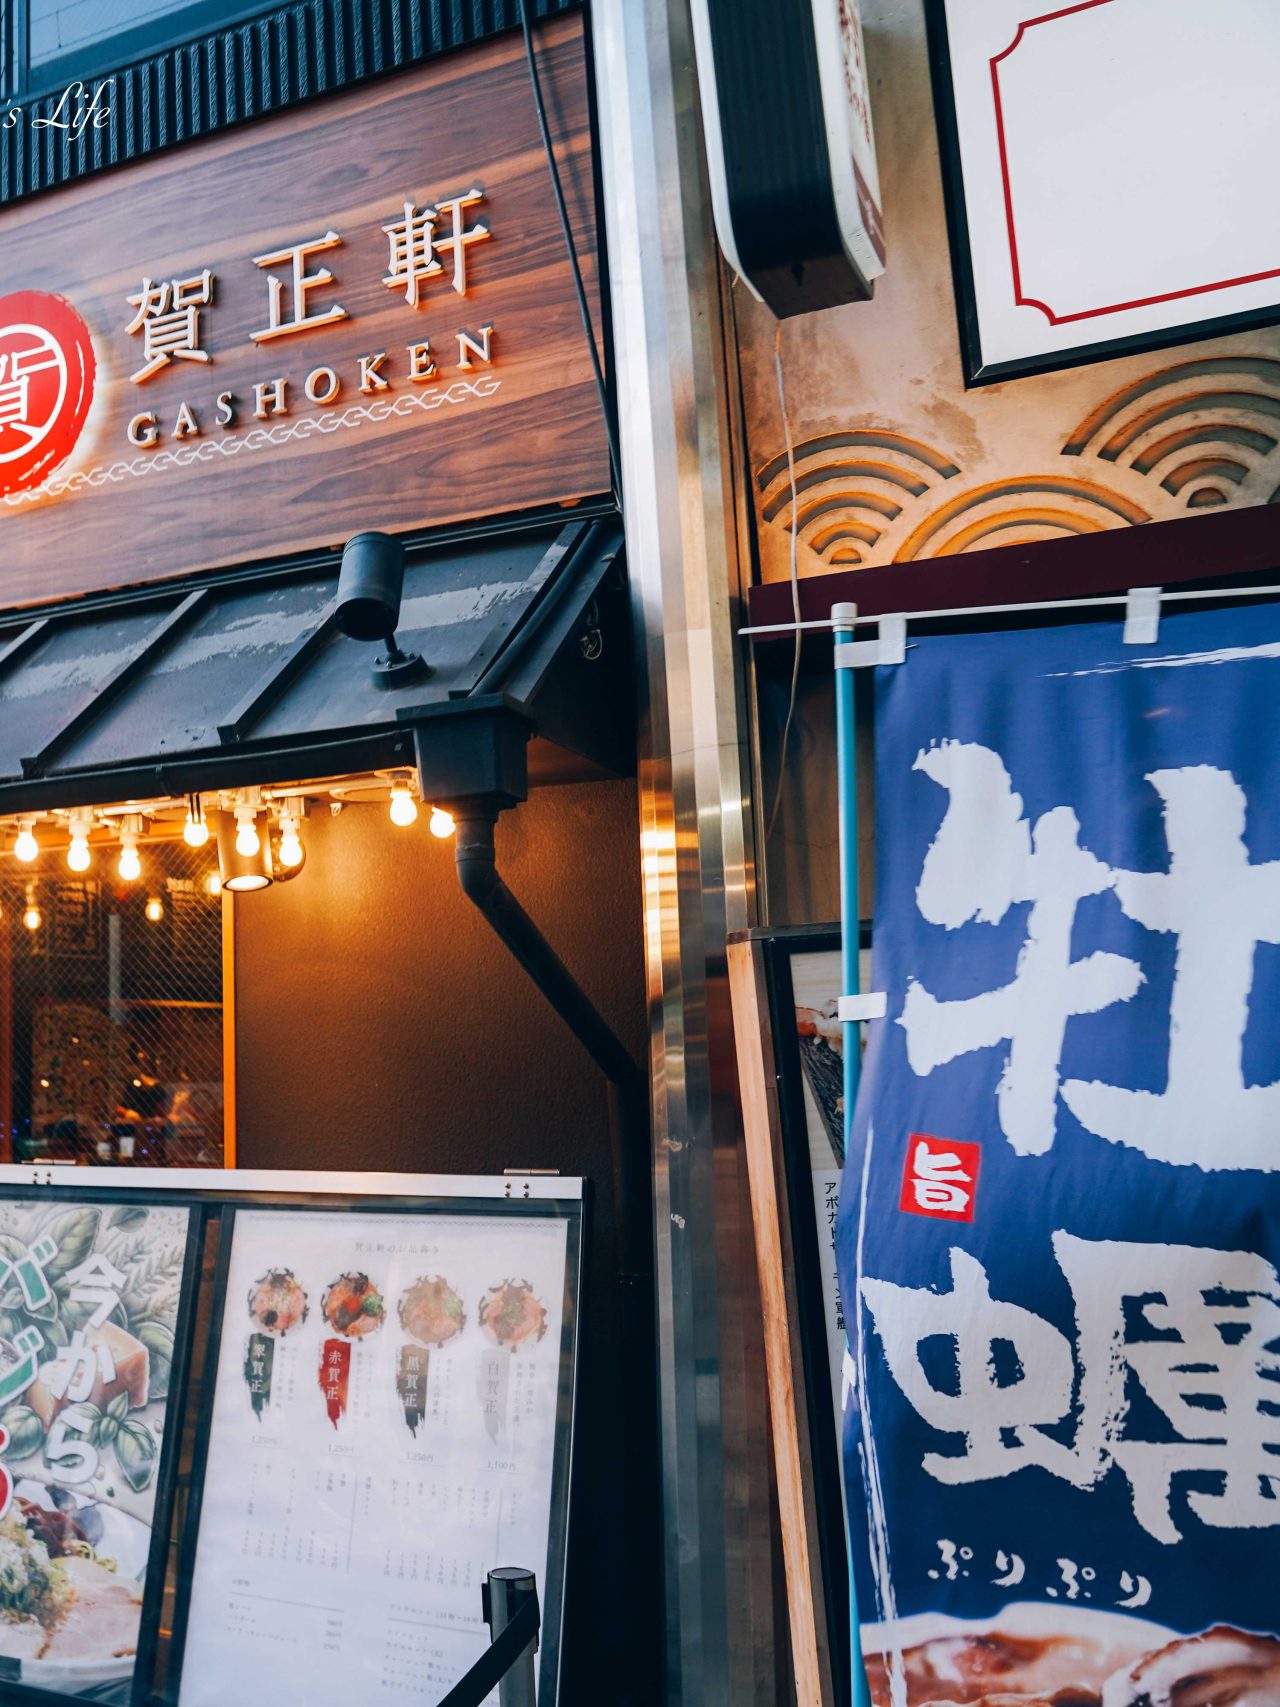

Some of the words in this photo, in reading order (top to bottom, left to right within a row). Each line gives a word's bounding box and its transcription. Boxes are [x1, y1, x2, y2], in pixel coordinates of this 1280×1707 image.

[125, 188, 491, 384] 賀正軒
[127, 326, 495, 448] GASHOKEN
[911, 1141, 973, 1212] 旨
[327, 1349, 342, 1401] 赤賀正
[483, 1361, 500, 1414] 白賀正
[927, 1538, 1152, 1608] ぷりぷり
